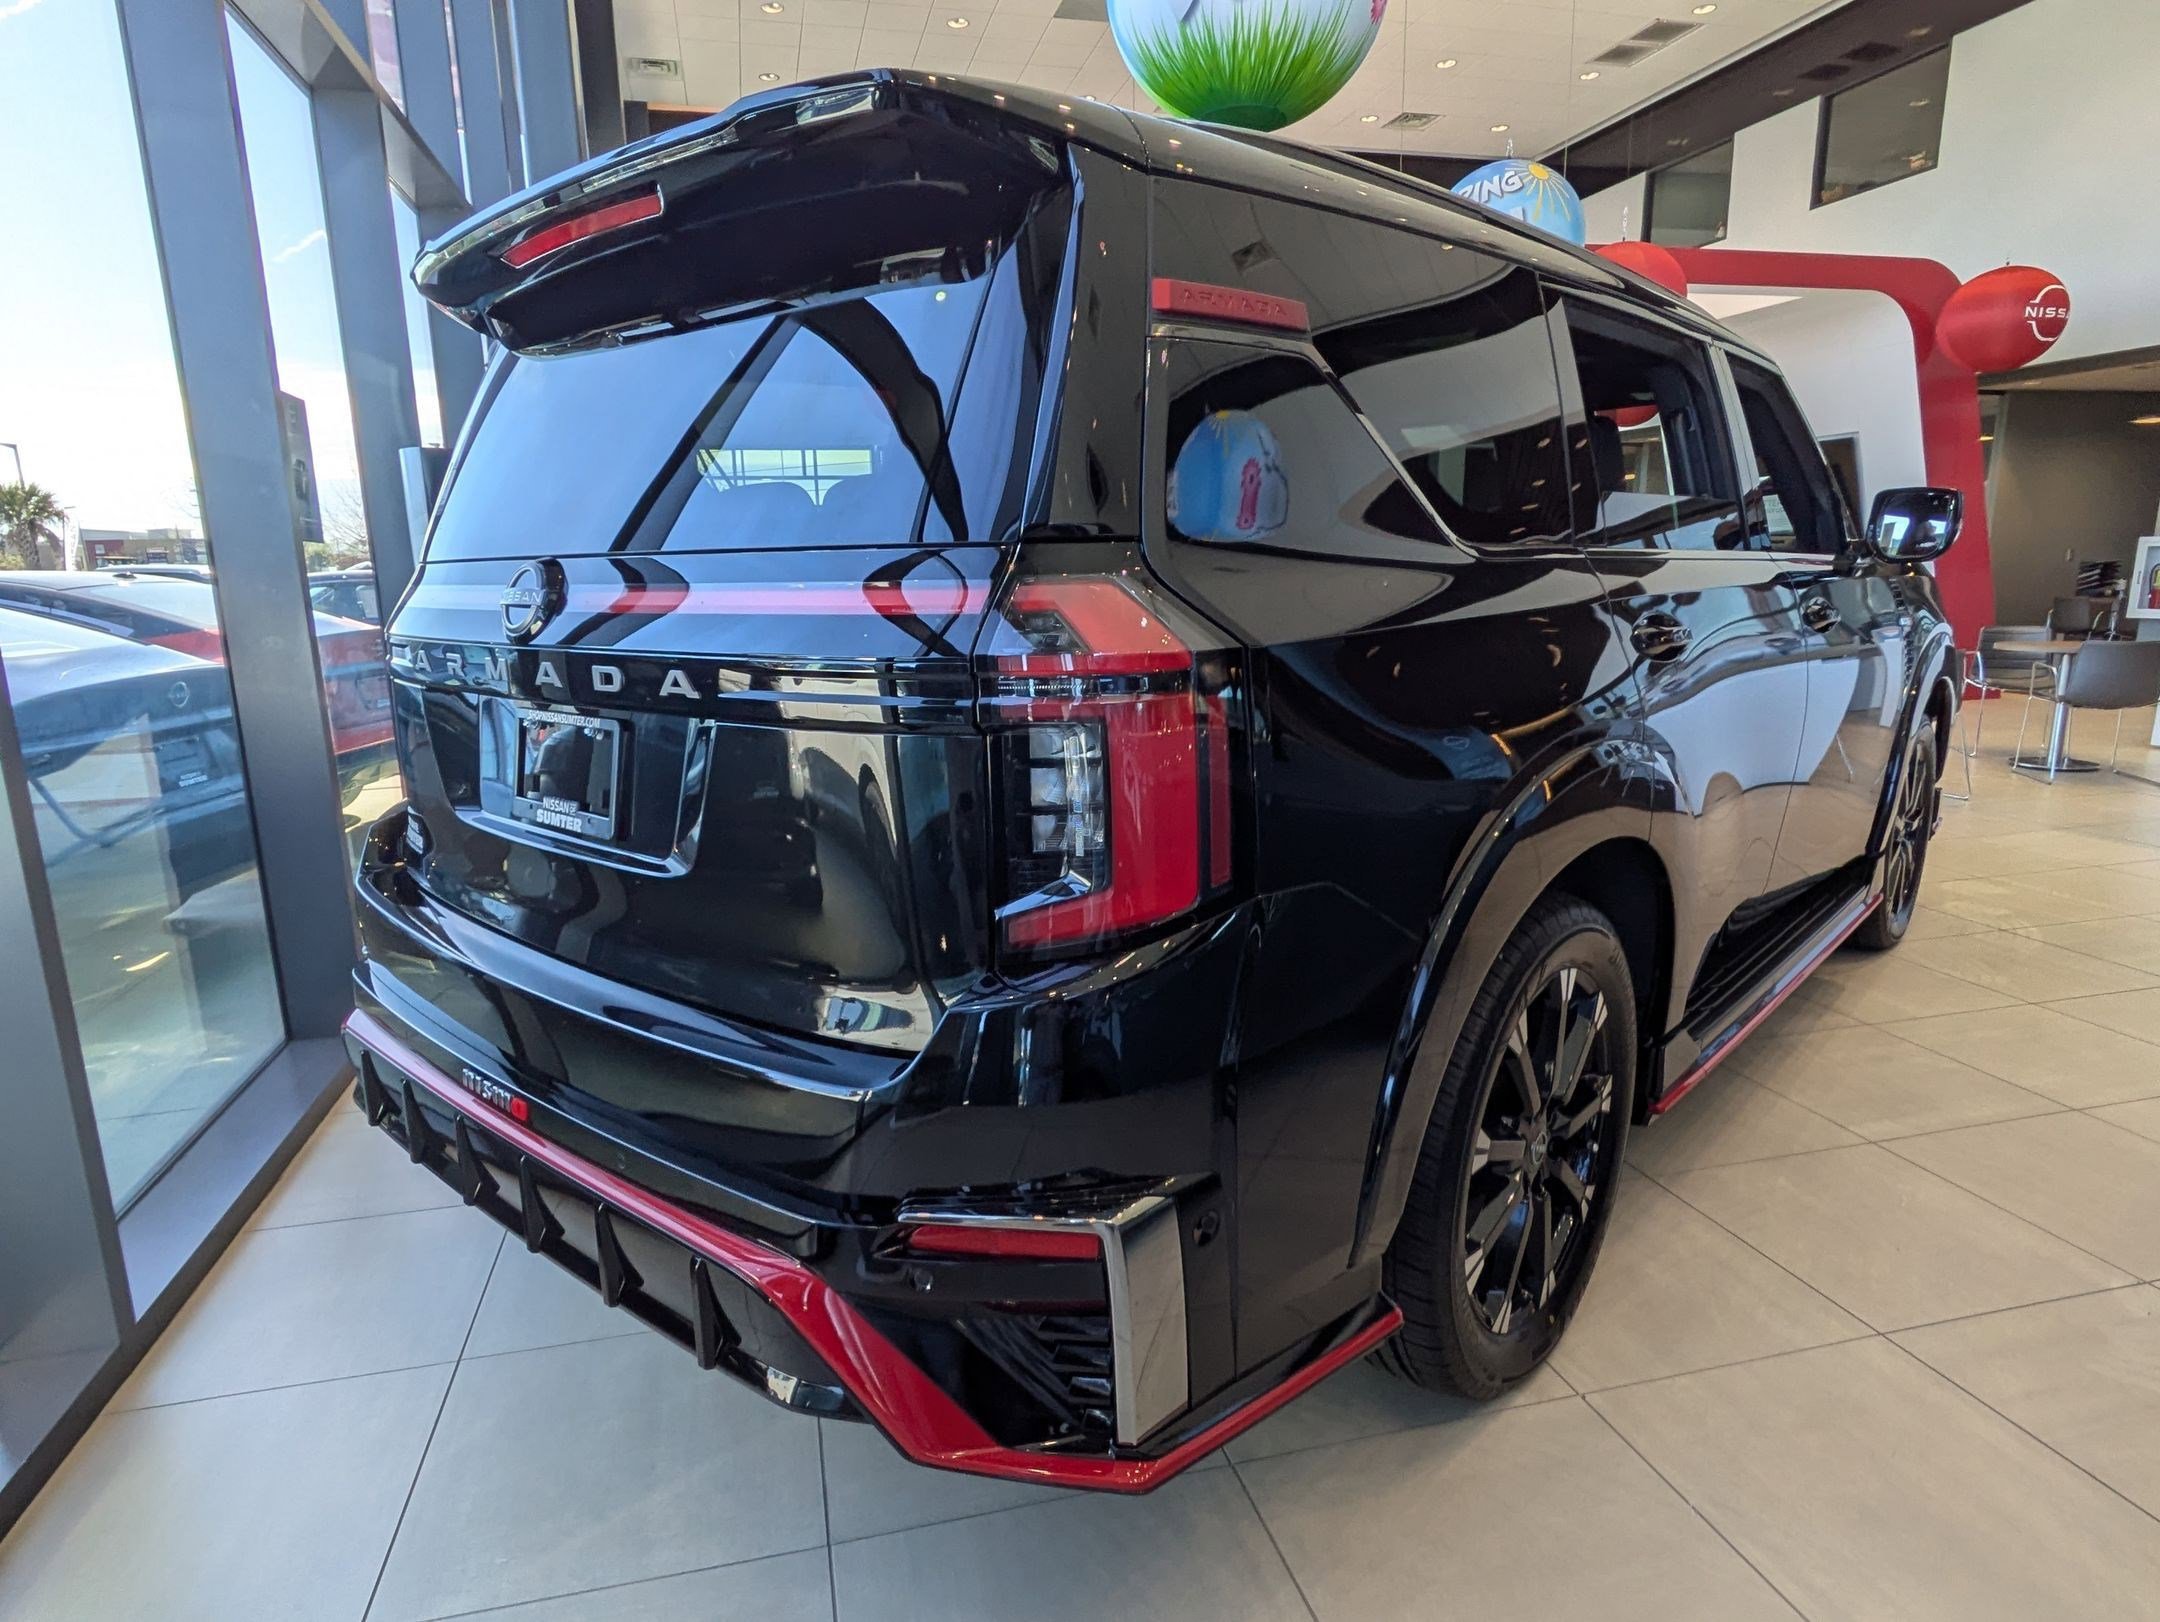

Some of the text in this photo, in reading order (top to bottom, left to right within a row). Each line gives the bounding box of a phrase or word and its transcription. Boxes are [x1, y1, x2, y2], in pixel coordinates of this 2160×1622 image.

[2024, 306, 2068, 319] NISS
[414, 649, 700, 700] ARMADA
[527, 710, 601, 729] SHOPNISSANSUMTER.COM
[542, 797, 570, 814] NISSAN
[536, 809, 582, 833] SUMTER
